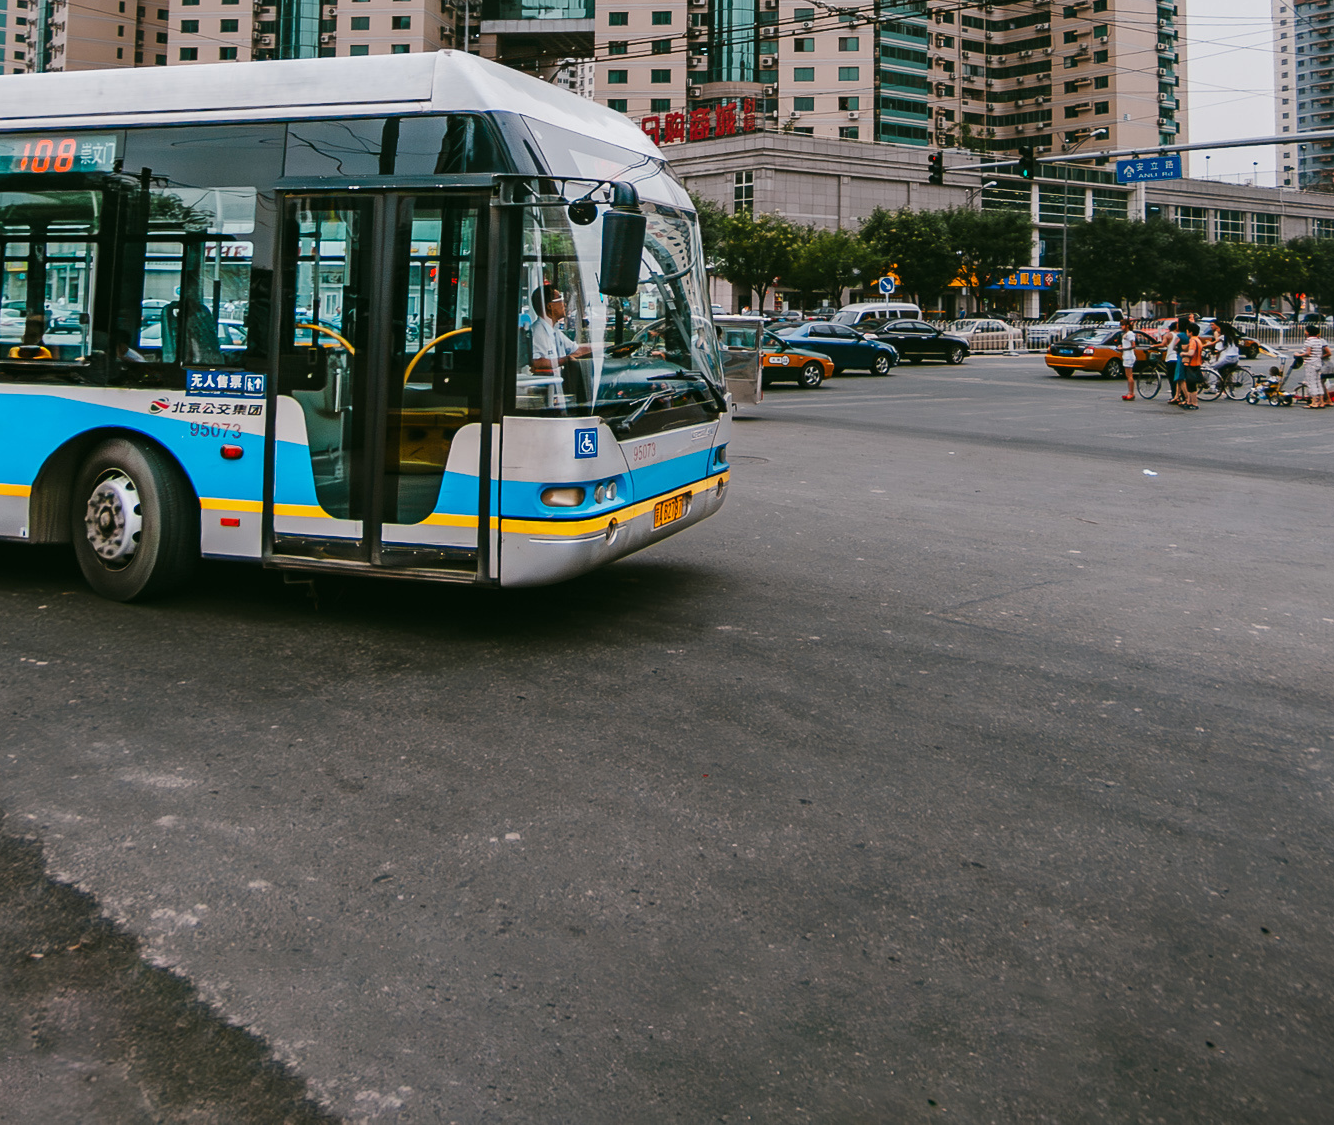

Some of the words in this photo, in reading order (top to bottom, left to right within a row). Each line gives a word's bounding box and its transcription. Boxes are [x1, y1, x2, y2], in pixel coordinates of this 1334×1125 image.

[20, 138, 77, 173] 108
[80, 142, 116, 165] 崇文门
[1136, 160, 1174, 172] 安立路
[191, 373, 243, 389] 无人售票
[172, 401, 263, 416] 北京公交集团
[190, 421, 242, 439] 95073
[633, 441, 656, 462] 95073
